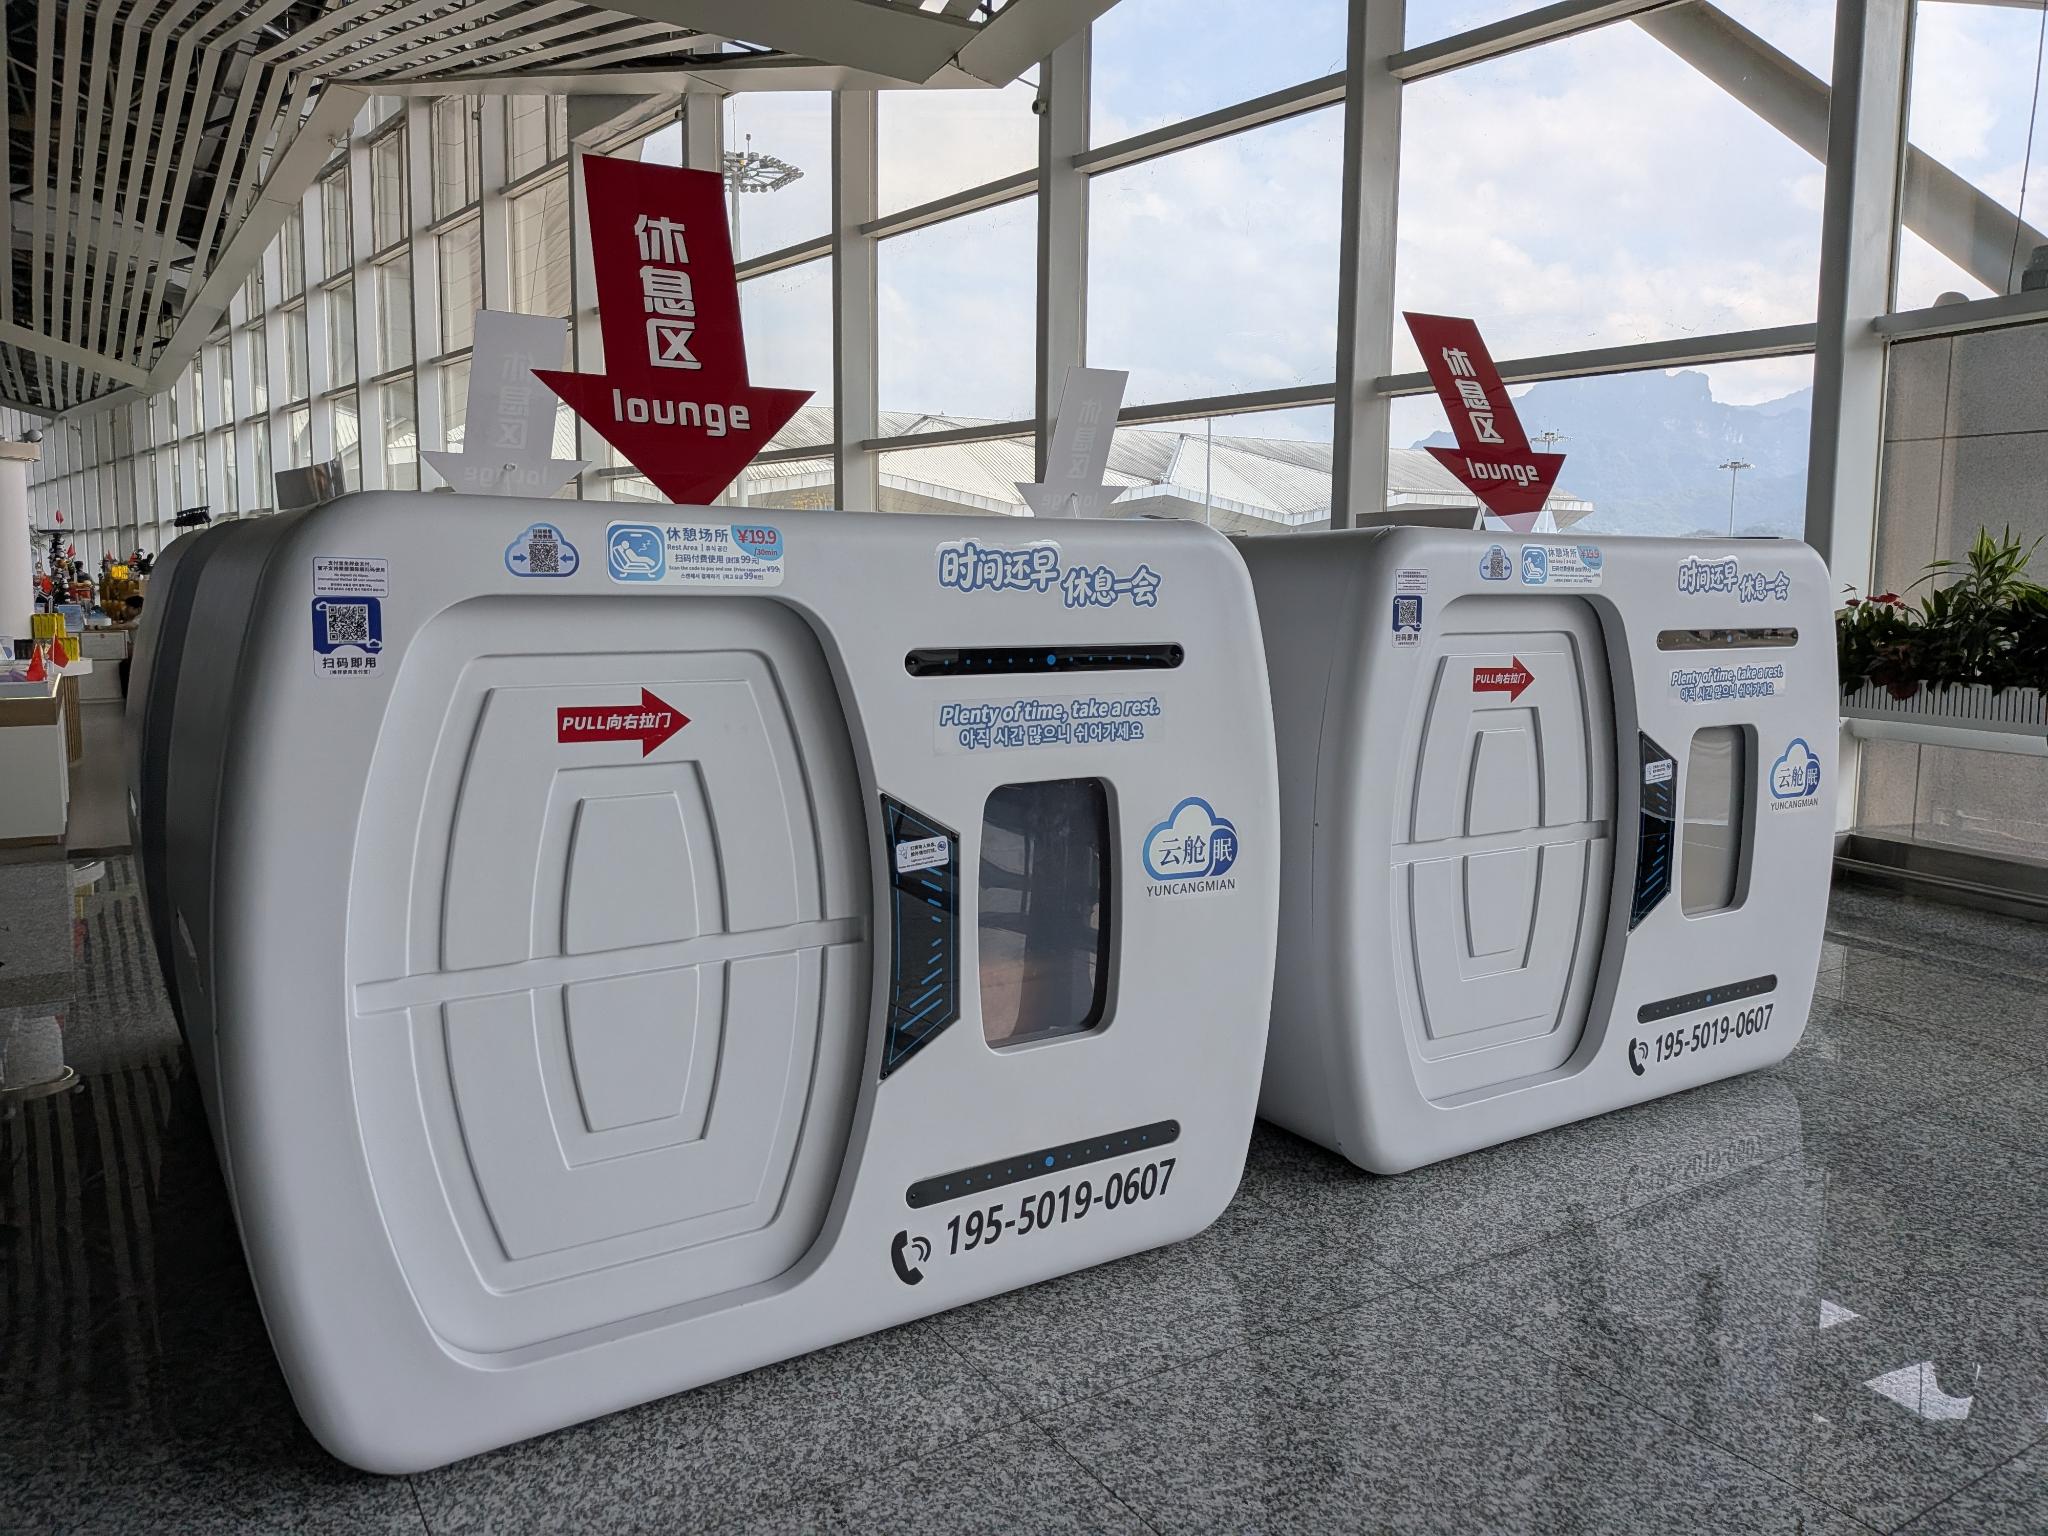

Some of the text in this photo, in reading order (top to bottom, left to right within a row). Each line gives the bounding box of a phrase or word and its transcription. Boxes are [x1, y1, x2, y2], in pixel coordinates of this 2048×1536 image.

[634, 214, 702, 370] 休息区
[1442, 347, 1505, 443] 休息区
[612, 388, 750, 437] lounge
[1465, 457, 1540, 487] lounge
[667, 527, 728, 542] 休憩场所
[736, 529, 777, 544] ¥19.9
[940, 542, 1161, 608] 时间还早 休息一会
[1678, 560, 1790, 603] 时间还早 休息一会
[322, 657, 376, 669] 扫码即用
[1671, 664, 1784, 687] Plenty of time, take a rest.
[562, 712, 672, 731] PULL向右拉门
[940, 697, 1161, 727] Plenty of time, take a rest.
[959, 721, 1144, 749] 아직 시간 많으니 쉬어가세요
[1770, 797, 1819, 811] YUNCANGMIAN
[1158, 835, 1233, 866] 云舱眠
[1146, 879, 1235, 897] YUNCANGMIAN
[1655, 1003, 1774, 1063] 195-5019-0607
[946, 1157, 1176, 1256] 195-5019-0607
